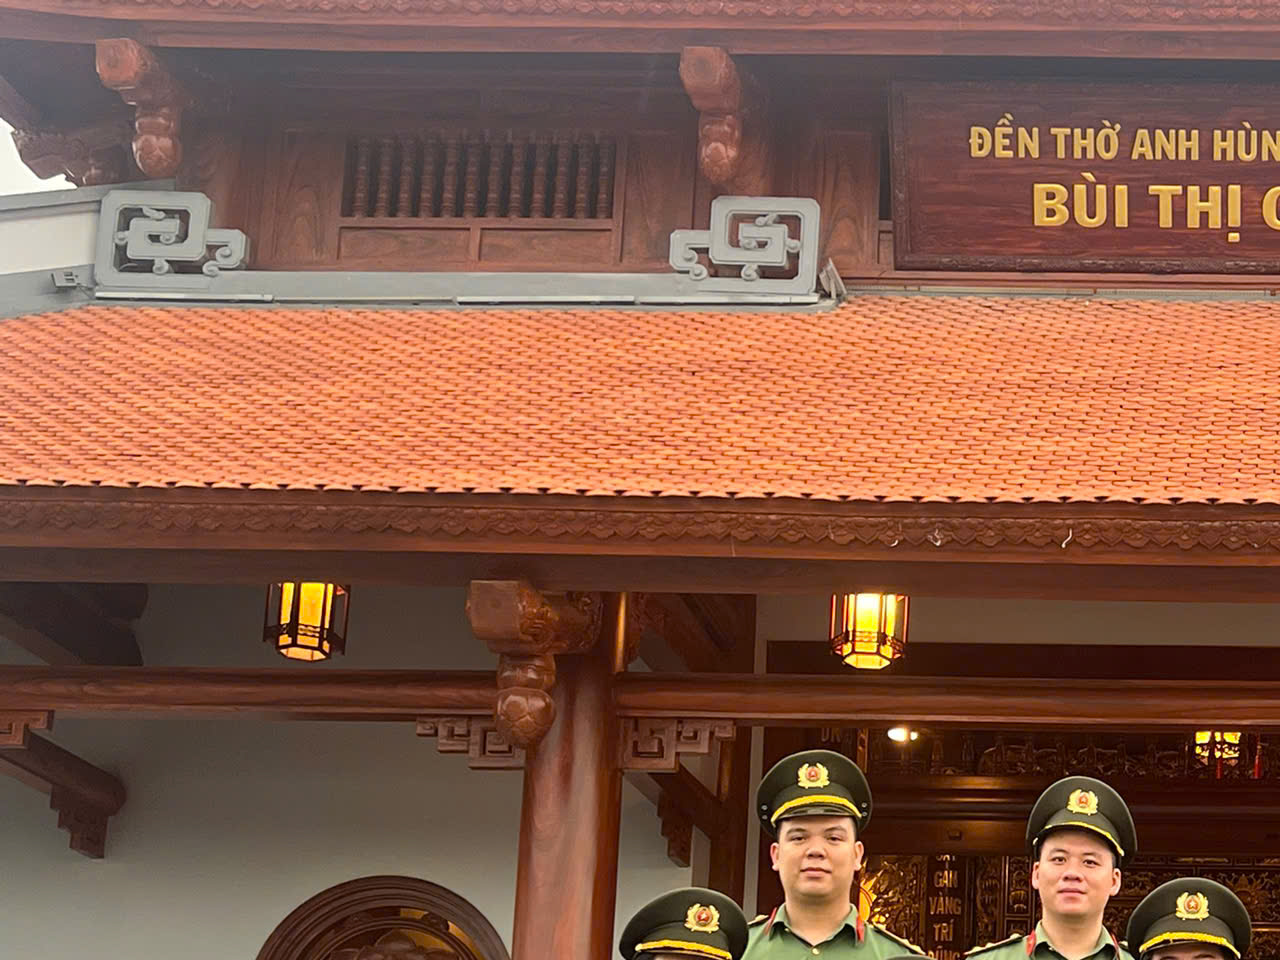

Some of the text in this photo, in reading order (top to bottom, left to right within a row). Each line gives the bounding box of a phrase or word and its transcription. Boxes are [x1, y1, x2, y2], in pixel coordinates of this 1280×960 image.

[969, 112, 1040, 158] ĐỀN
[1050, 119, 1122, 160] THỜ
[1130, 128, 1199, 161] ANH
[1033, 172, 1129, 228] BÙI
[1148, 184, 1242, 243] THỊ
